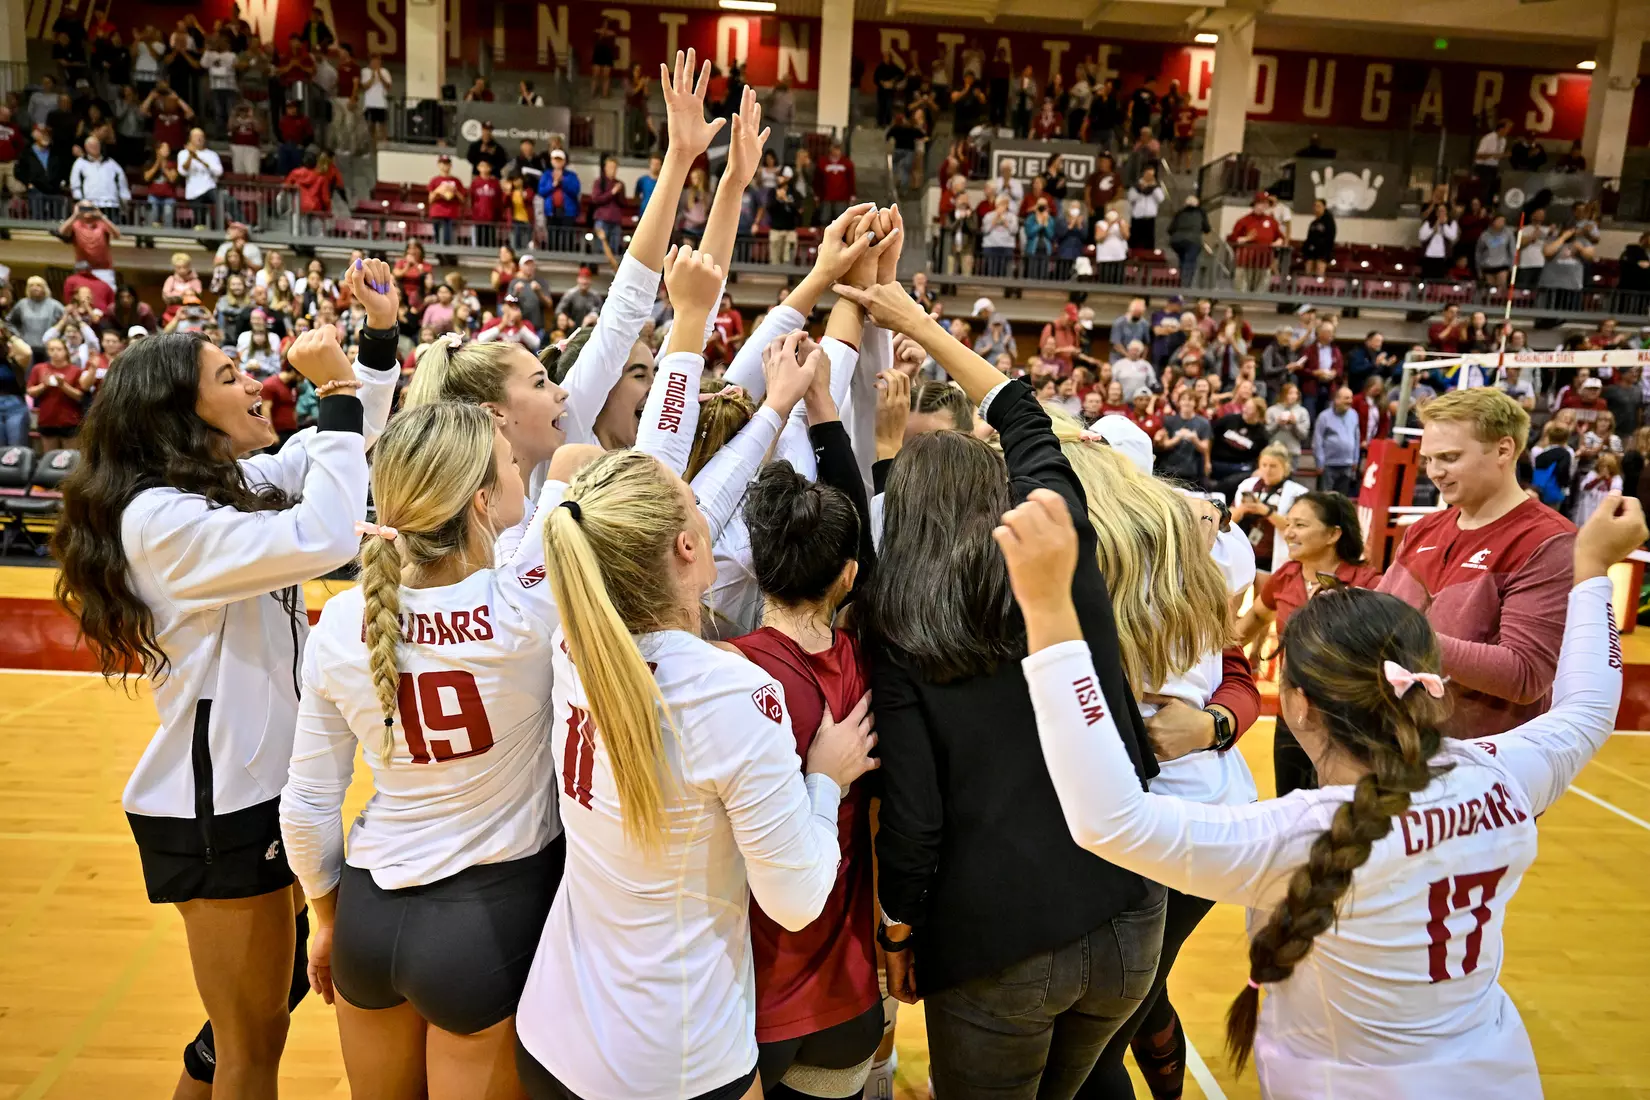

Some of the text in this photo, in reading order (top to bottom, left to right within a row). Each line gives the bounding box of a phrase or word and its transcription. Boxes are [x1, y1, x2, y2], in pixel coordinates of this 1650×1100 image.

[1188, 48, 1558, 132] COUGARS
[1000, 157, 1087, 180] BEU
[657, 372, 688, 434] COUGARS
[361, 604, 494, 645] UGARS
[397, 670, 494, 764] 19
[769, 704, 782, 719] 12
[1072, 676, 1105, 726] WSU
[1427, 865, 1509, 984] 17
